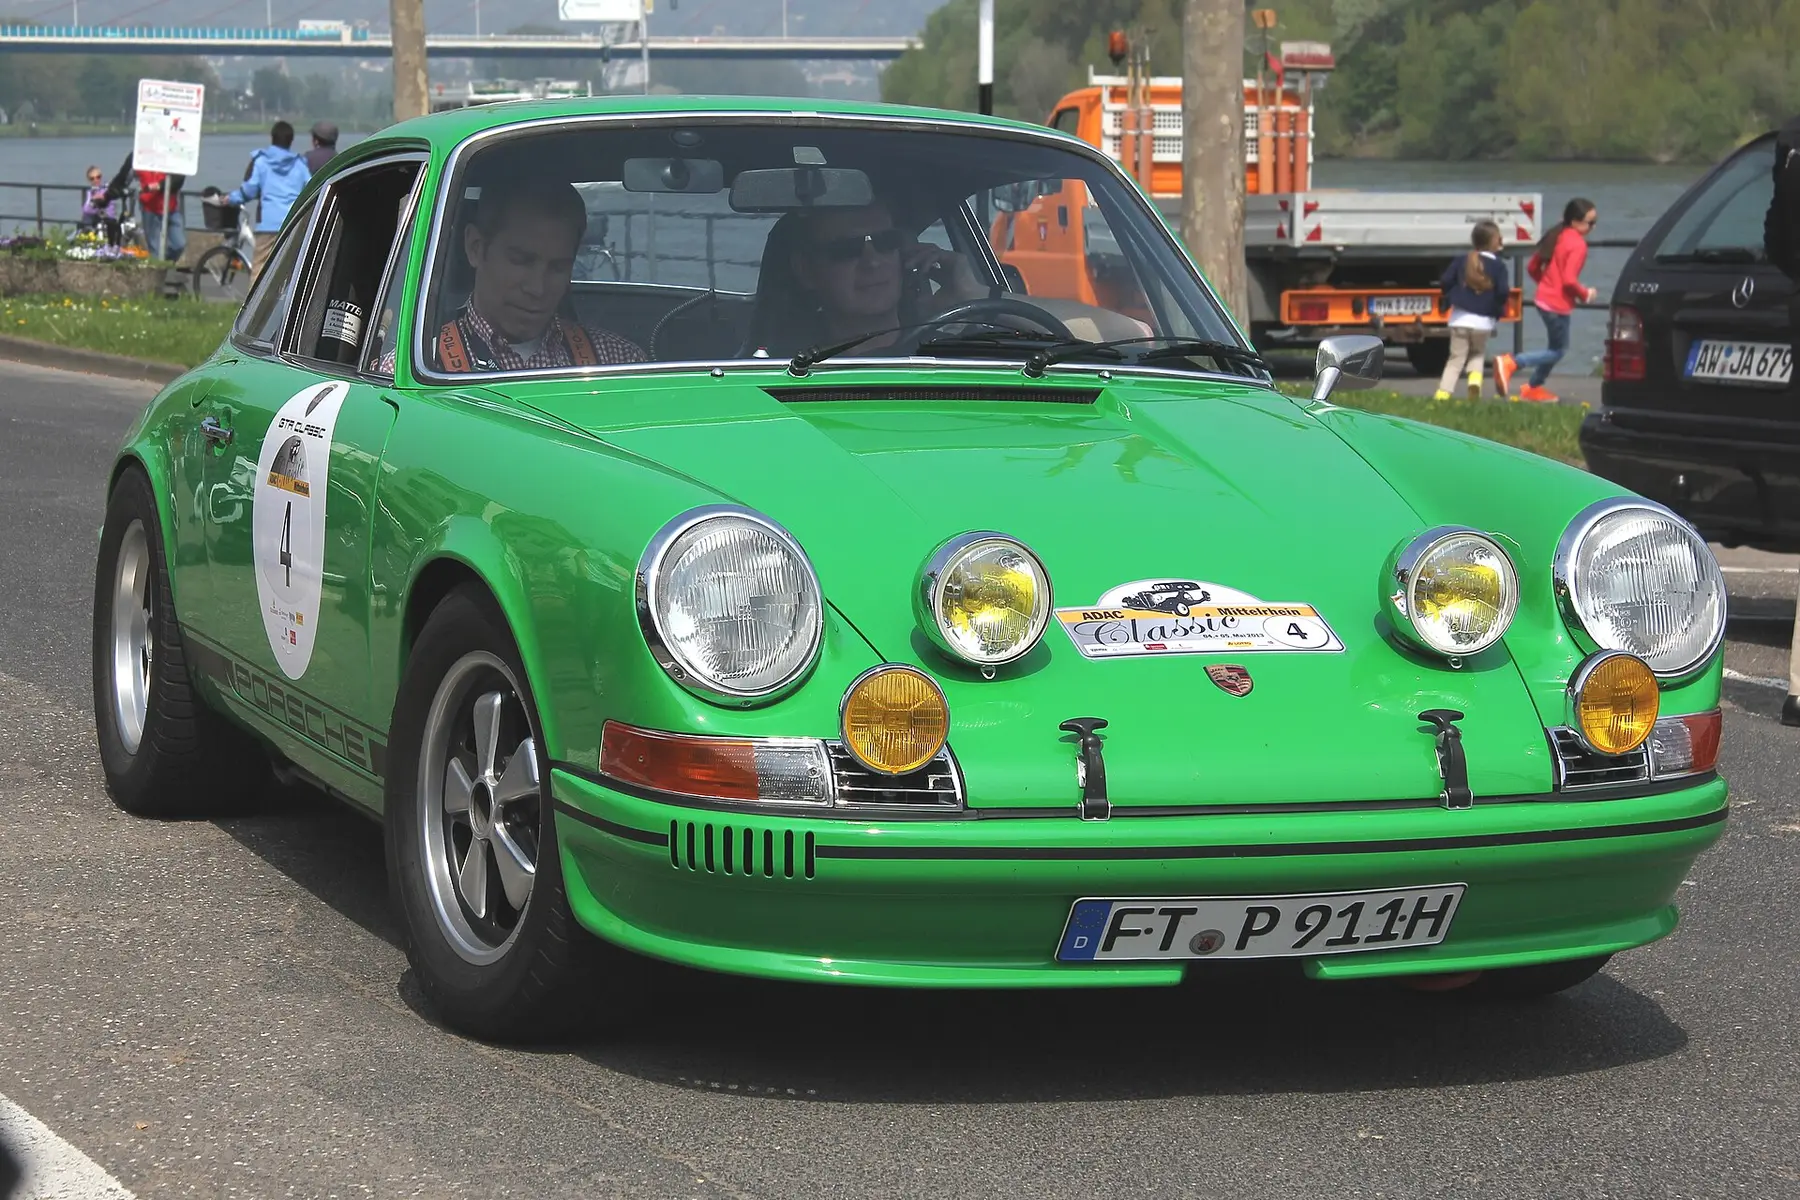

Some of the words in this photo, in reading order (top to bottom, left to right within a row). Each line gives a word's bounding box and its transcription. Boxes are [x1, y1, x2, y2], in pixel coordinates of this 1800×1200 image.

[328, 299, 363, 317] MATTE
[1695, 344, 1723, 374] AW
[1729, 345, 1755, 376] JA
[1756, 347, 1793, 379] 679
[280, 500, 292, 587] 4
[1073, 613, 1240, 647] Classic
[1082, 610, 1125, 621] ADAC
[1217, 607, 1302, 616] Mittelrhein
[1287, 623, 1308, 640] 4
[232, 660, 368, 771] PORSCHE
[1073, 935, 1089, 950] D
[1234, 905, 1281, 951] P
